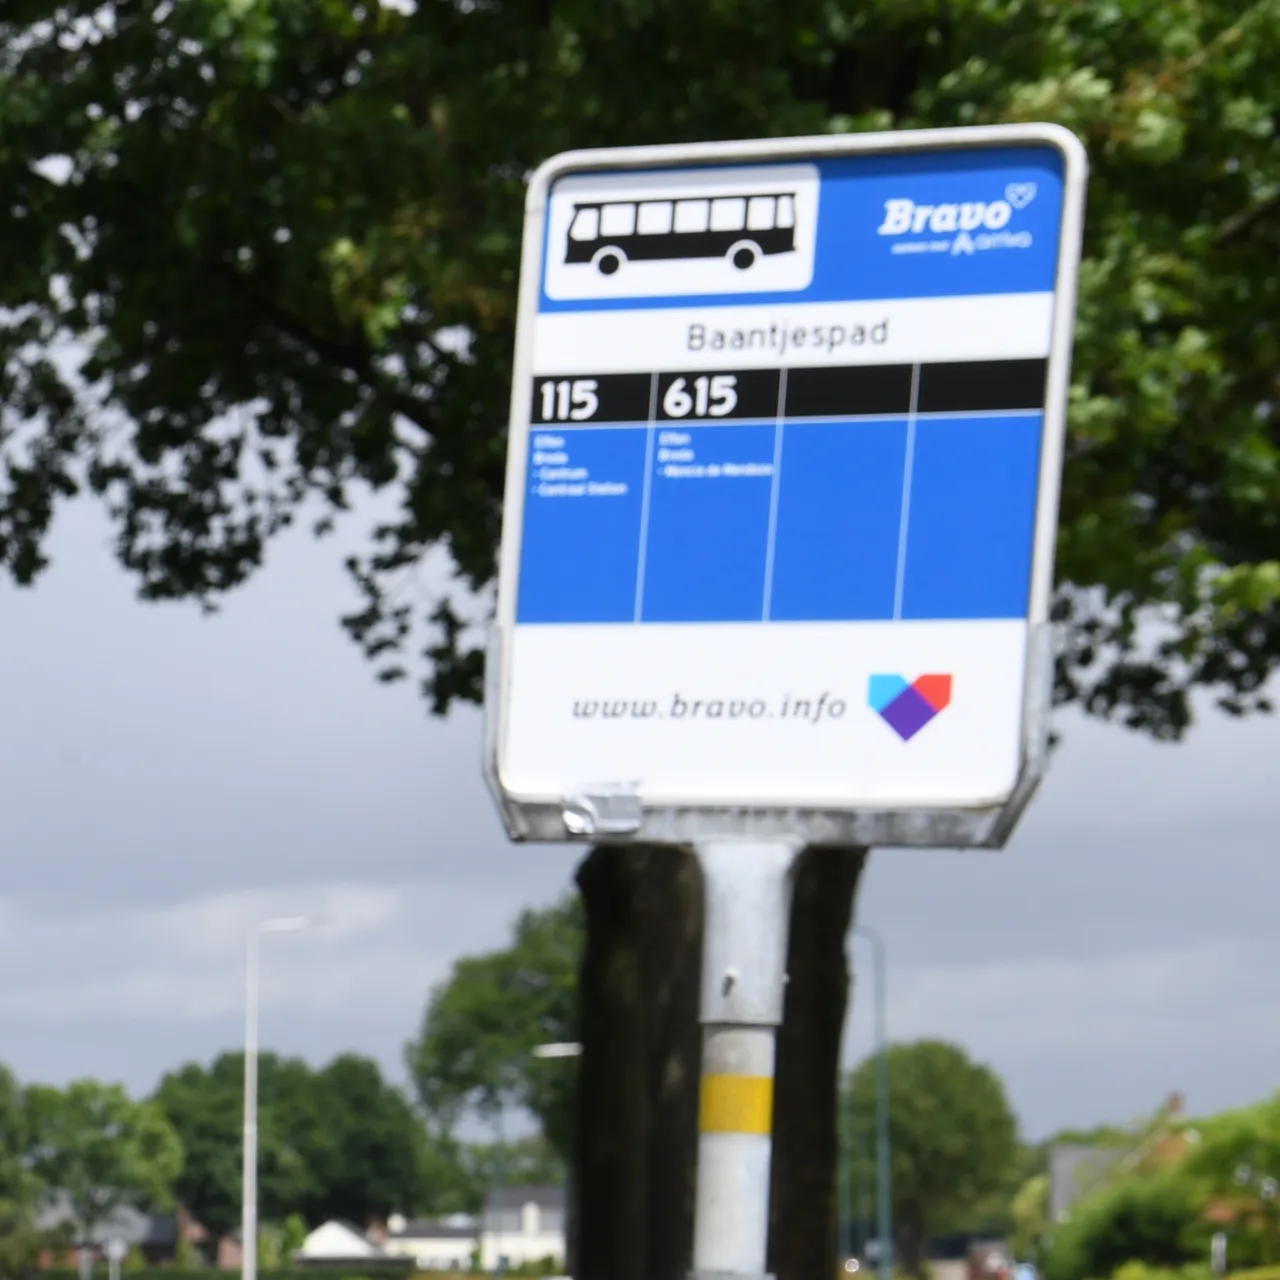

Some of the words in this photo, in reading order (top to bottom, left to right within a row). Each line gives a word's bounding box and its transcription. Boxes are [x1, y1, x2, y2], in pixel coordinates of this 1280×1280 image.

[877, 198, 1012, 235] Bravo
[688, 318, 890, 357] Baantjespad
[541, 379, 599, 421] 115
[663, 375, 738, 418] 615
[572, 692, 847, 724] www.bravo.info
